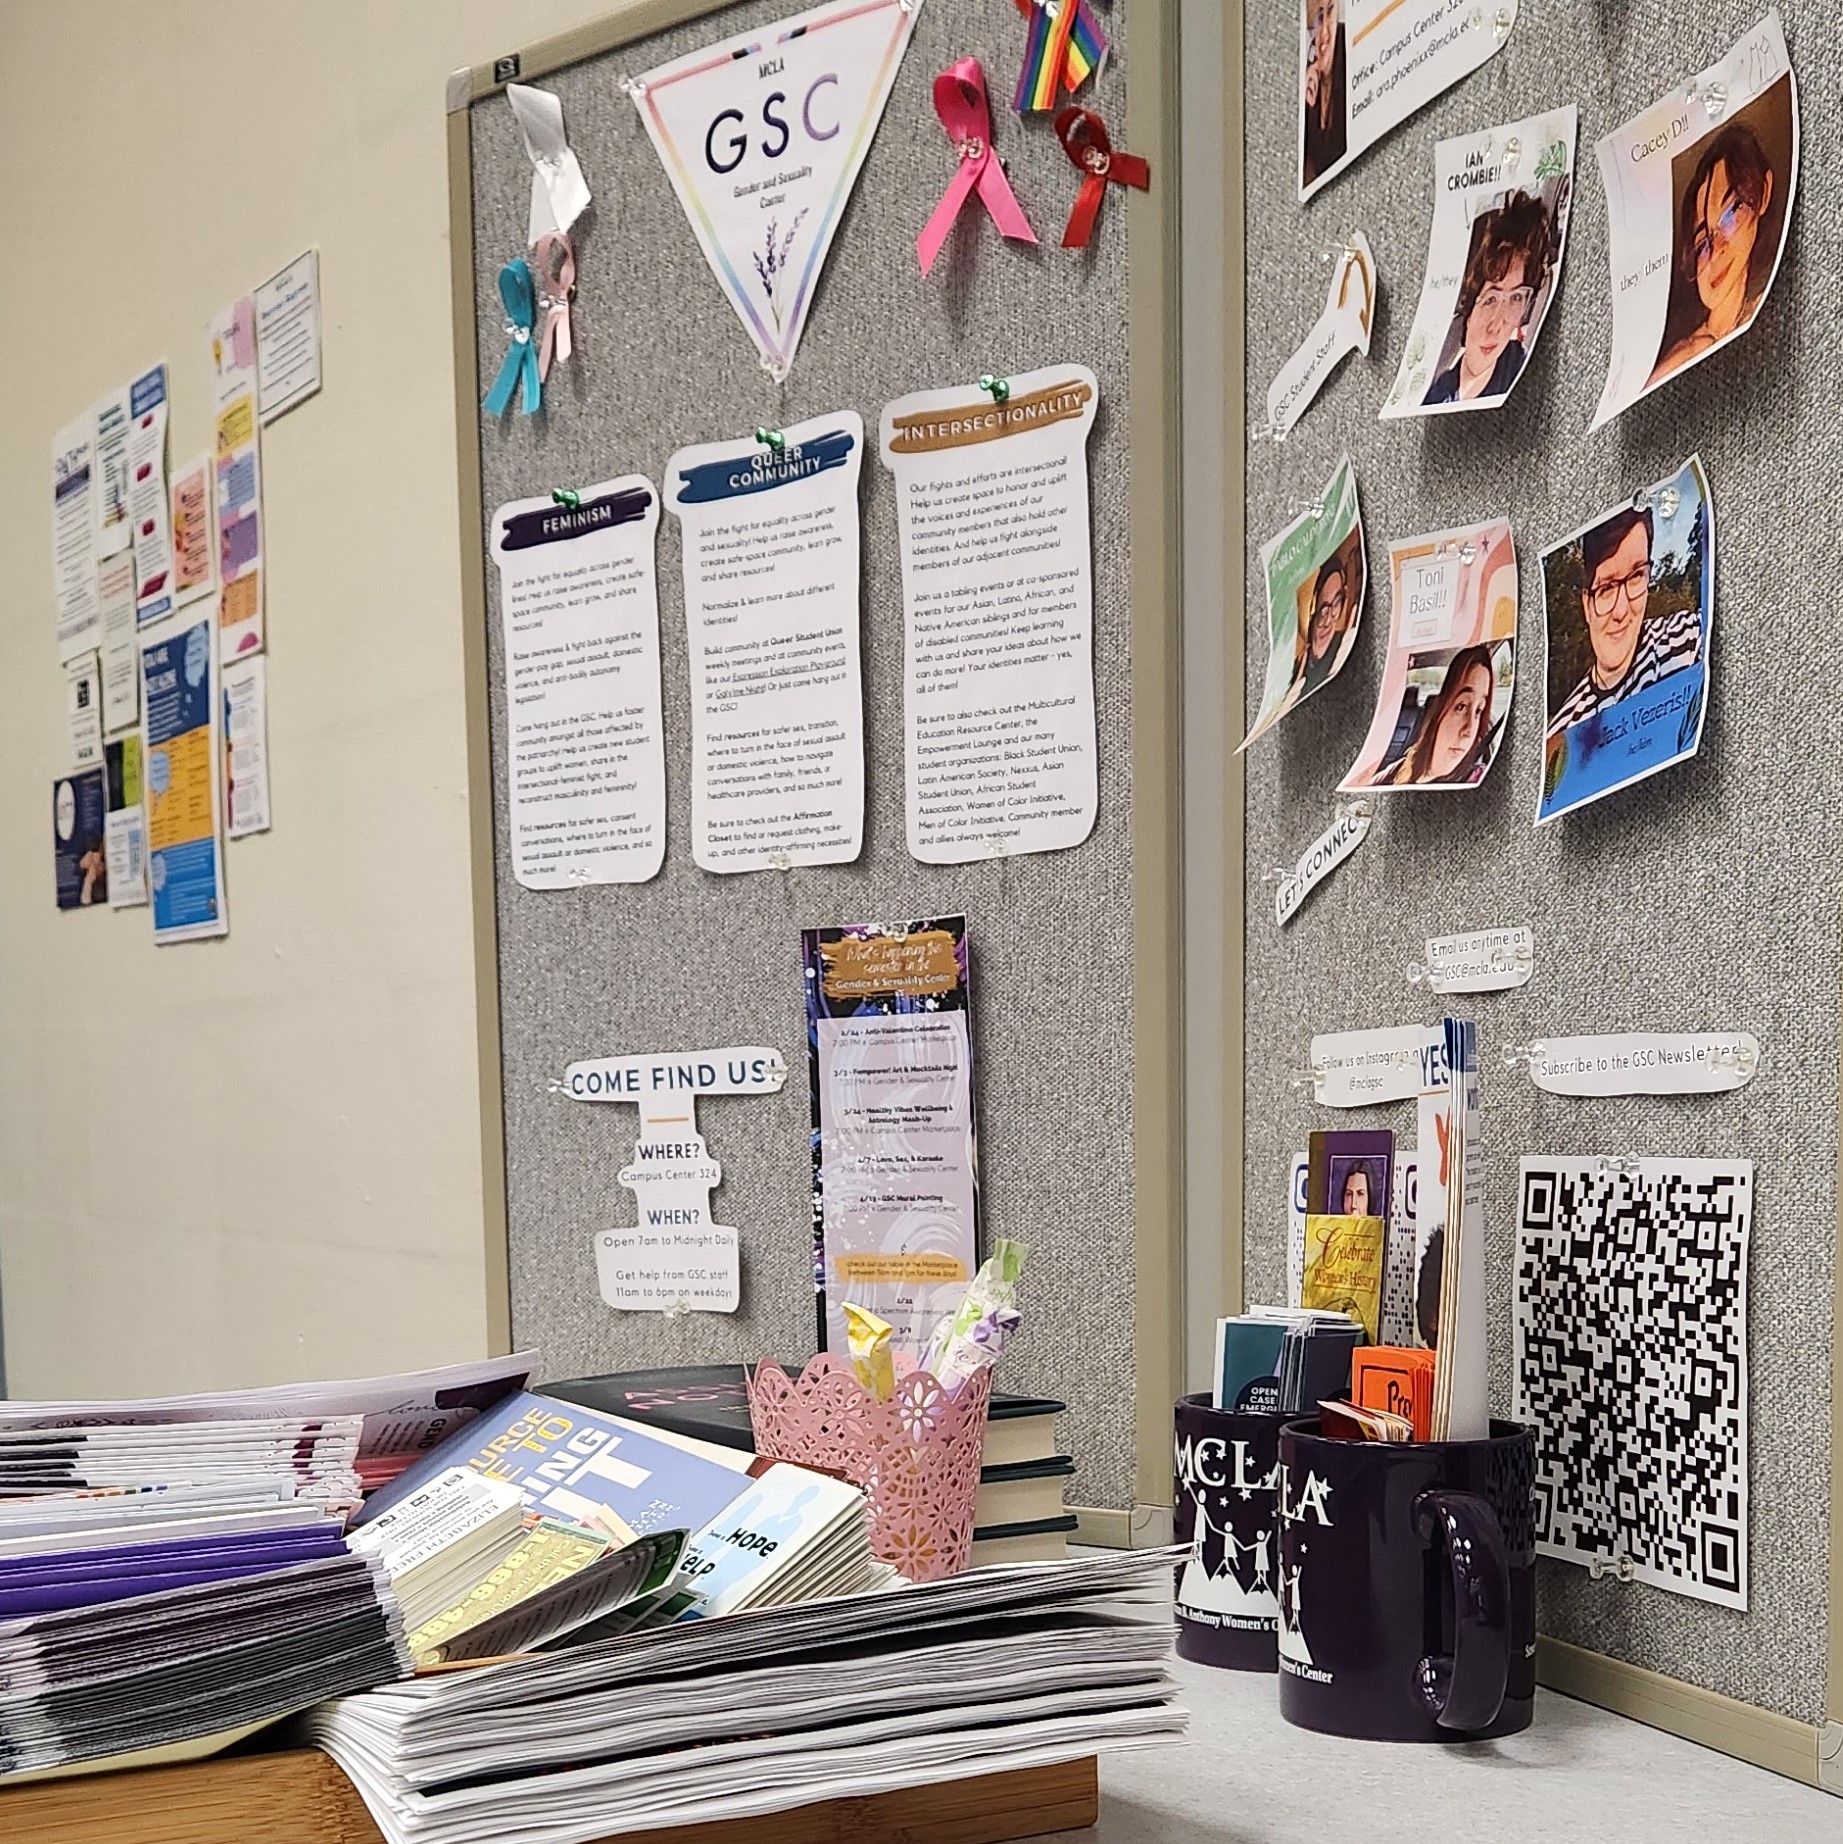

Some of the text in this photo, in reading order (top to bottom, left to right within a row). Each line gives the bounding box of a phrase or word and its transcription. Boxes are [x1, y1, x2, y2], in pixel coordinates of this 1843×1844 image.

[1379, 33, 1412, 66] Campus
[1414, 7, 1444, 38] Center
[758, 56, 784, 79] MCLA
[1352, 89, 1374, 120] Email:
[705, 73, 840, 174] GSC
[1630, 114, 1689, 163] Cacey D!!
[1466, 150, 1484, 169] IAN
[734, 166, 812, 198] Gender and Sexuality
[1447, 164, 1502, 192] CROMBIE!!
[760, 193, 786, 208] Center
[901, 391, 1084, 442] INTERSECTIONALITY
[751, 446, 802, 470] QUEER
[730, 455, 821, 488] COMMUNITY
[909, 455, 1068, 492] Our fights and efforts are intersectional!
[910, 498, 931, 509] Help
[944, 494, 970, 503] create
[972, 489, 994, 500] space
[995, 486, 1003, 494] to
[1005, 482, 1028, 492] honor
[1030, 477, 1046, 488] and
[1048, 473, 1066, 485] uplift
[542, 504, 612, 534] FEMINISM
[1416, 566, 1444, 588] Toni
[1410, 588, 1447, 614] Basil!!
[916, 715, 927, 724] Be
[929, 715, 945, 723] sure
[956, 710, 972, 719] also
[973, 706, 997, 717] check
[998, 705, 1012, 714] out
[1013, 703, 1026, 712] the
[1632, 684, 1691, 730] Vezeris!!
[916, 718, 1037, 739] Education Resource Center, the
[917, 732, 1054, 754] Empowerment Lounge and our many
[917, 743, 1082, 770] student organizations: Black Student Union,
[966, 801, 995, 809] Women
[996, 797, 1005, 807] of
[1007, 796, 1027, 806] Color
[1306, 818, 1358, 879] CONNEC
[1431, 930, 1526, 956] Email us anytime at
[836, 974, 950, 988] Gender & Sexuality Center
[1322, 1056, 1344, 1070] Follow
[1346, 1056, 1354, 1067] us
[1356, 1056, 1364, 1066] on
[1366, 1050, 1408, 1065] Instagr
[1541, 1056, 1592, 1077] Subscribe
[1596, 1058, 1608, 1072] to
[1612, 1056, 1630, 1070] the
[1632, 1050, 1656, 1067] GSC
[572, 1058, 776, 1096] COME FIND US!
[638, 1143, 700, 1160] WHERE?
[621, 1168, 716, 1183] Campus Center 324
[646, 1209, 700, 1225] WHEN?
[604, 1234, 734, 1248] Open 7am to Midnight Daily
[1316, 1227, 1376, 1269] Celebrate
[616, 1270, 728, 1282] Get help from GSC staff
[1315, 1268, 1376, 1294] Women's History
[616, 1287, 639, 1296] 11am
[643, 1288, 653, 1296] to
[656, 1288, 675, 1298] 6pm
[694, 1288, 732, 1299] weekdays
[1250, 1387, 1278, 1397] OPEN
[1250, 1396, 1276, 1404] CASE
[512, 1416, 574, 1454] TO
[521, 1427, 610, 1500] ING
[427, 1504, 500, 1552] ELIZABETH
[1222, 1614, 1270, 1631] Women's
[1302, 1664, 1334, 1684] Center
